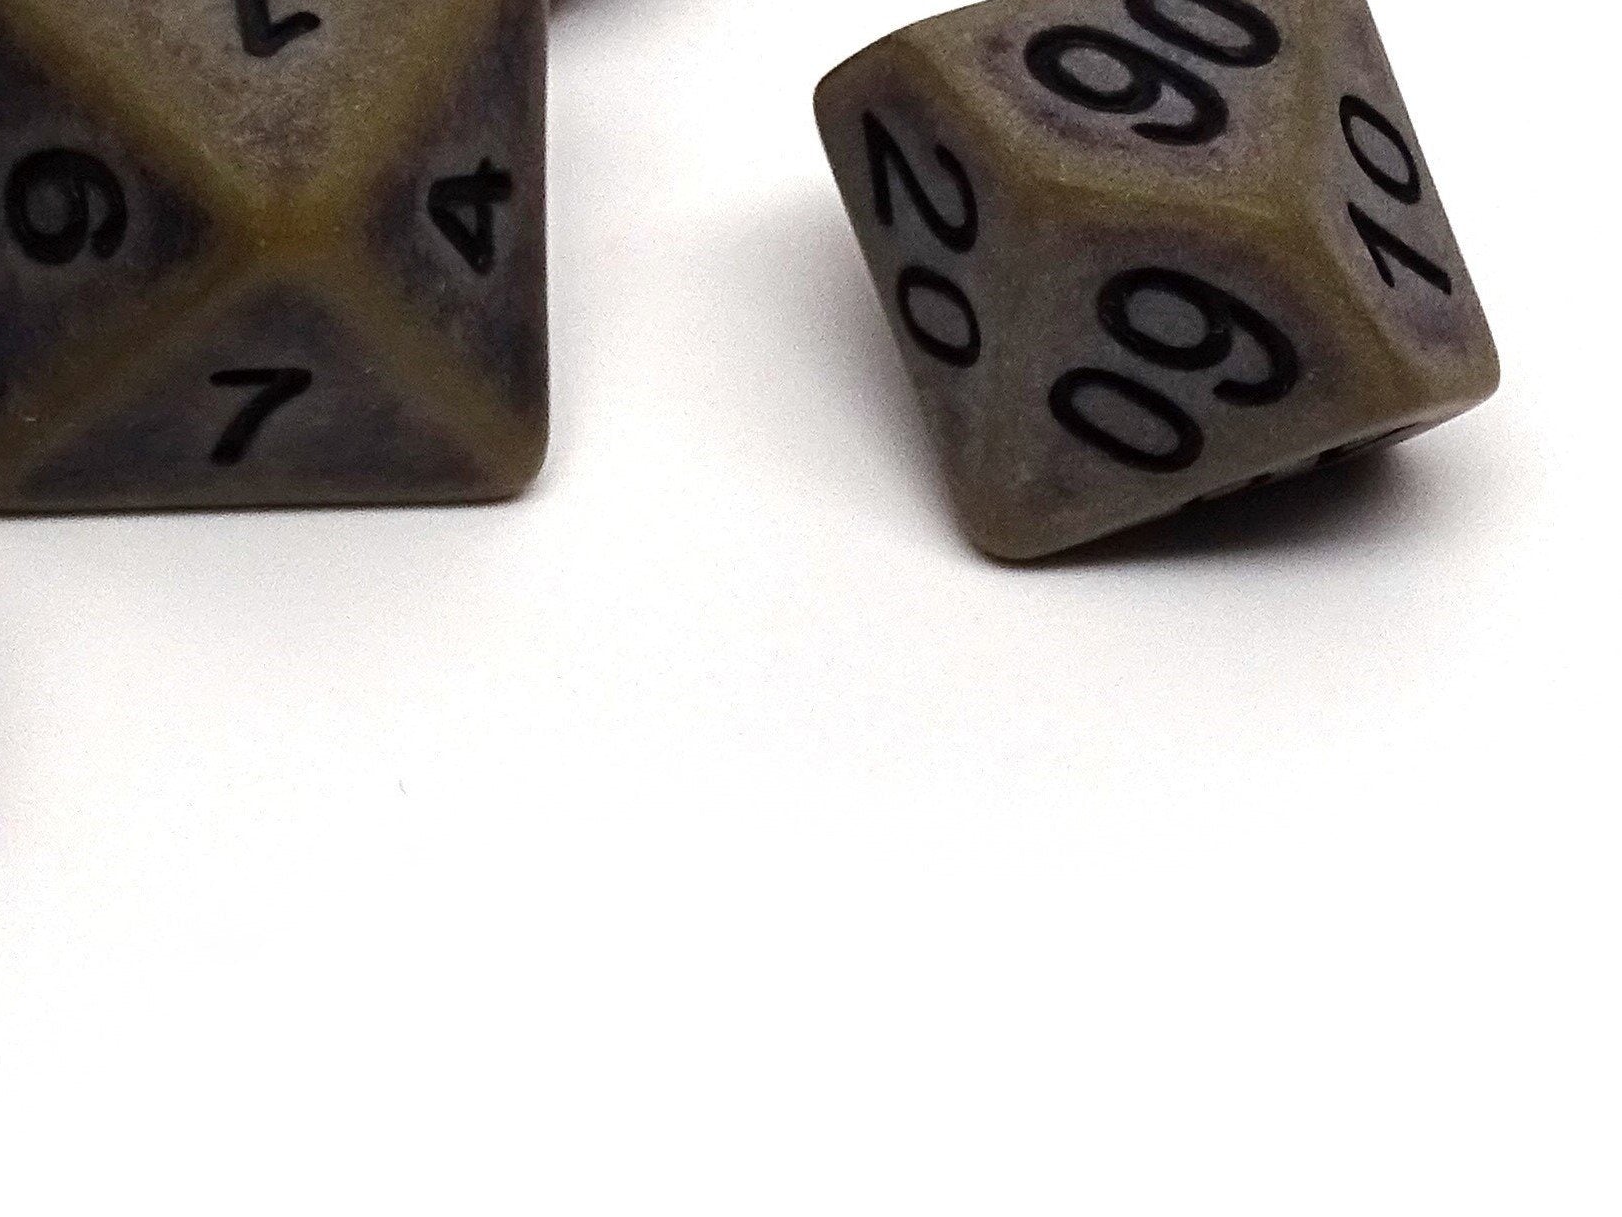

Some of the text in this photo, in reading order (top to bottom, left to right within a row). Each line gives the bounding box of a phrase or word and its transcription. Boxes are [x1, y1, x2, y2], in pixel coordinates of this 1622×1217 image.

[426, 154, 514, 276] 4
[862, 109, 982, 369] 20
[1338, 94, 1454, 296] 10
[210, 368, 314, 468] 7
[1047, 267, 1299, 474] 60
